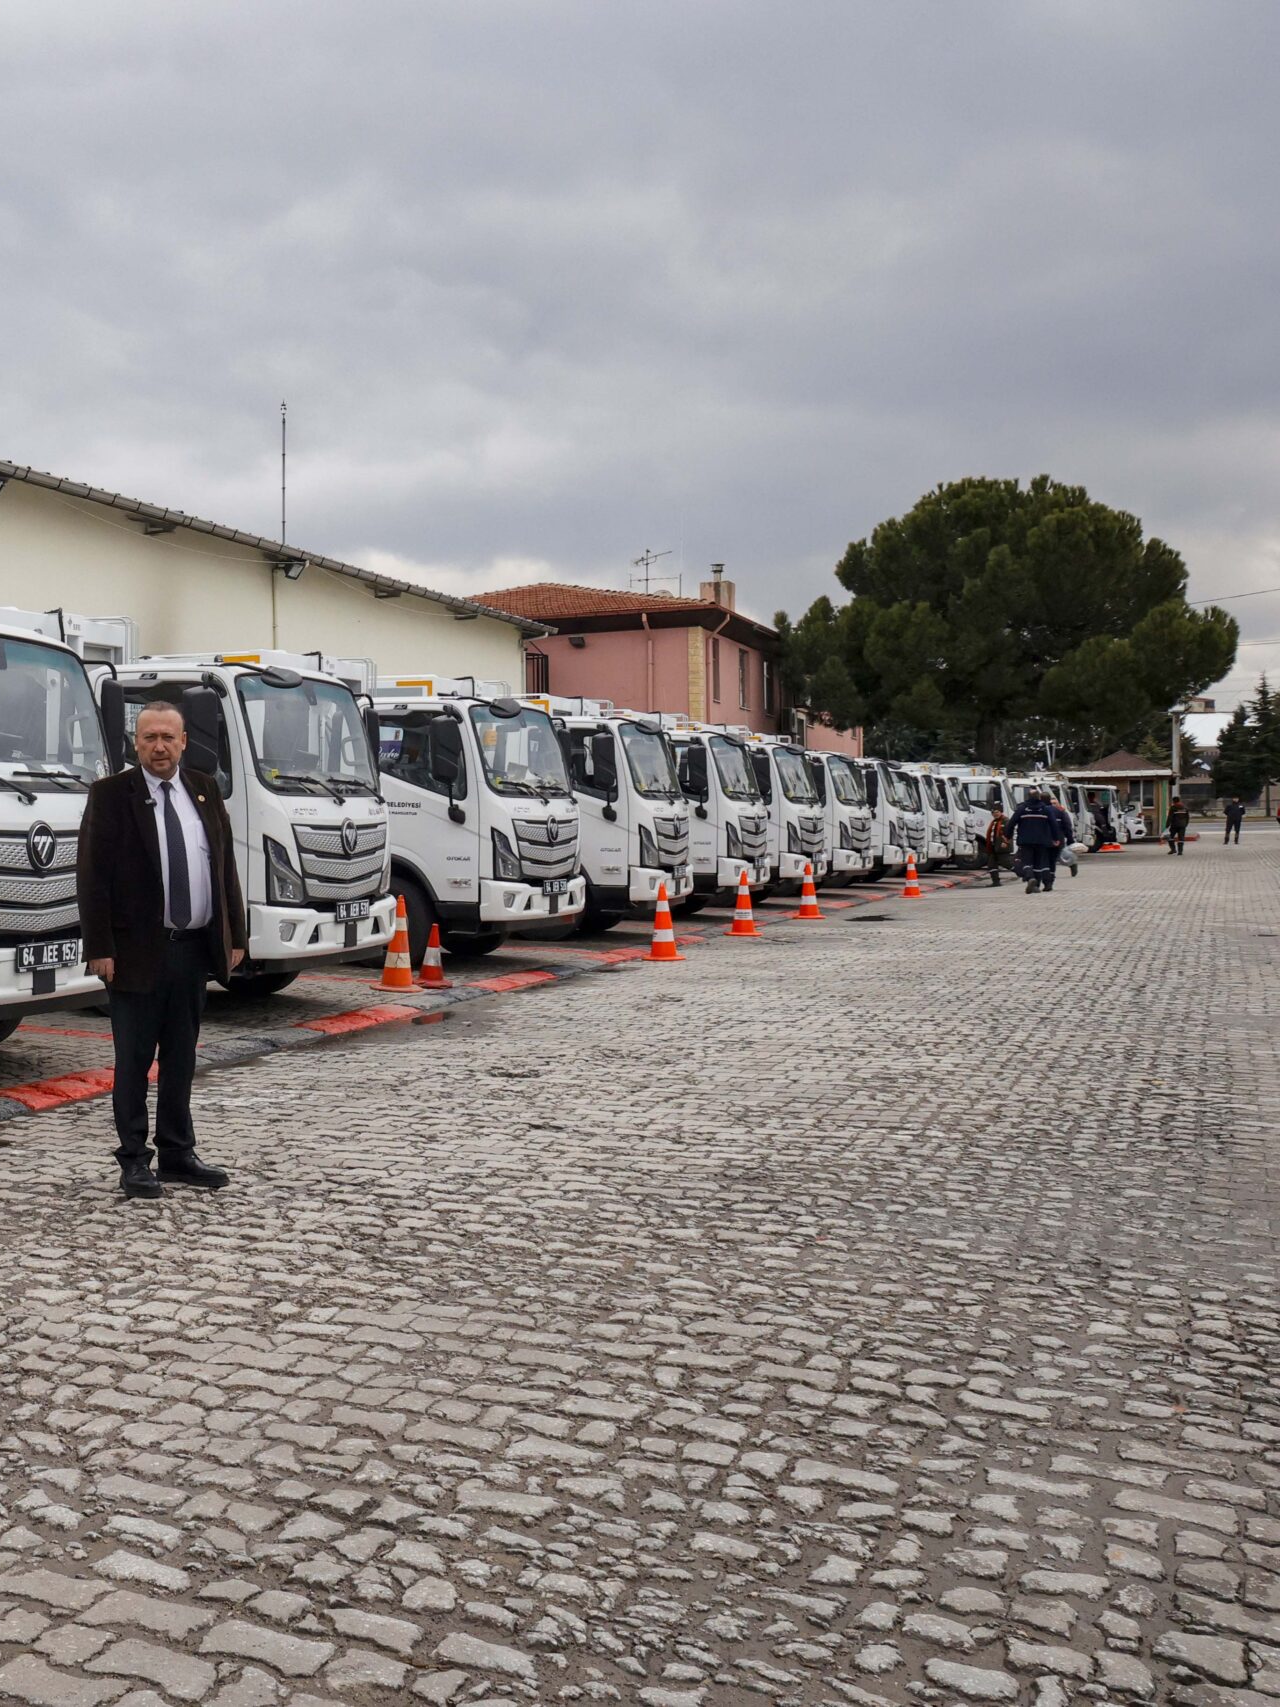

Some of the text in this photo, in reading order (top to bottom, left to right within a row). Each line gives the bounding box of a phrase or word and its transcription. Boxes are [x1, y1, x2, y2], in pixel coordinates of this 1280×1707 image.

[23, 942, 76, 966] 64 AEE 152
